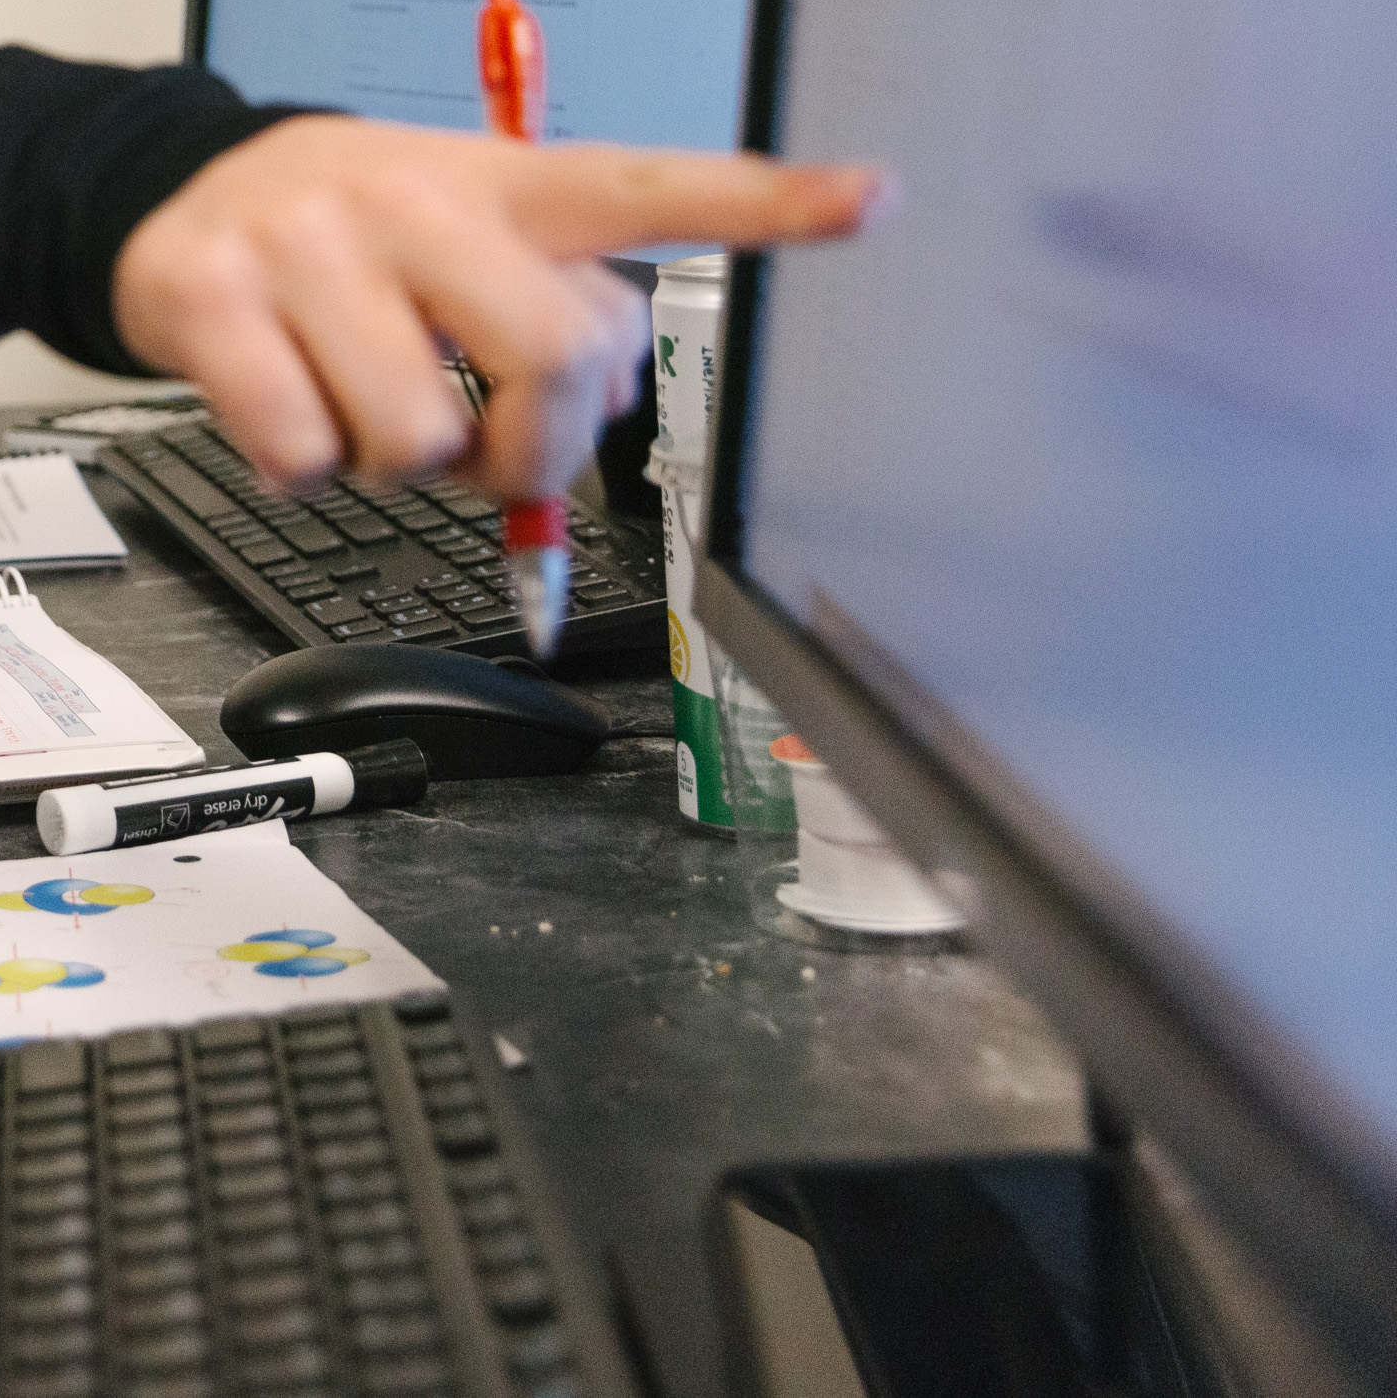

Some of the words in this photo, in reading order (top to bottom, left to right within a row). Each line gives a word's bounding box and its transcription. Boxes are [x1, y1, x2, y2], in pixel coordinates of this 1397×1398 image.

[680, 749, 687, 772] 5
[203, 798, 241, 815] erase
[243, 793, 268, 810] dry
[122, 826, 160, 842] chisel
